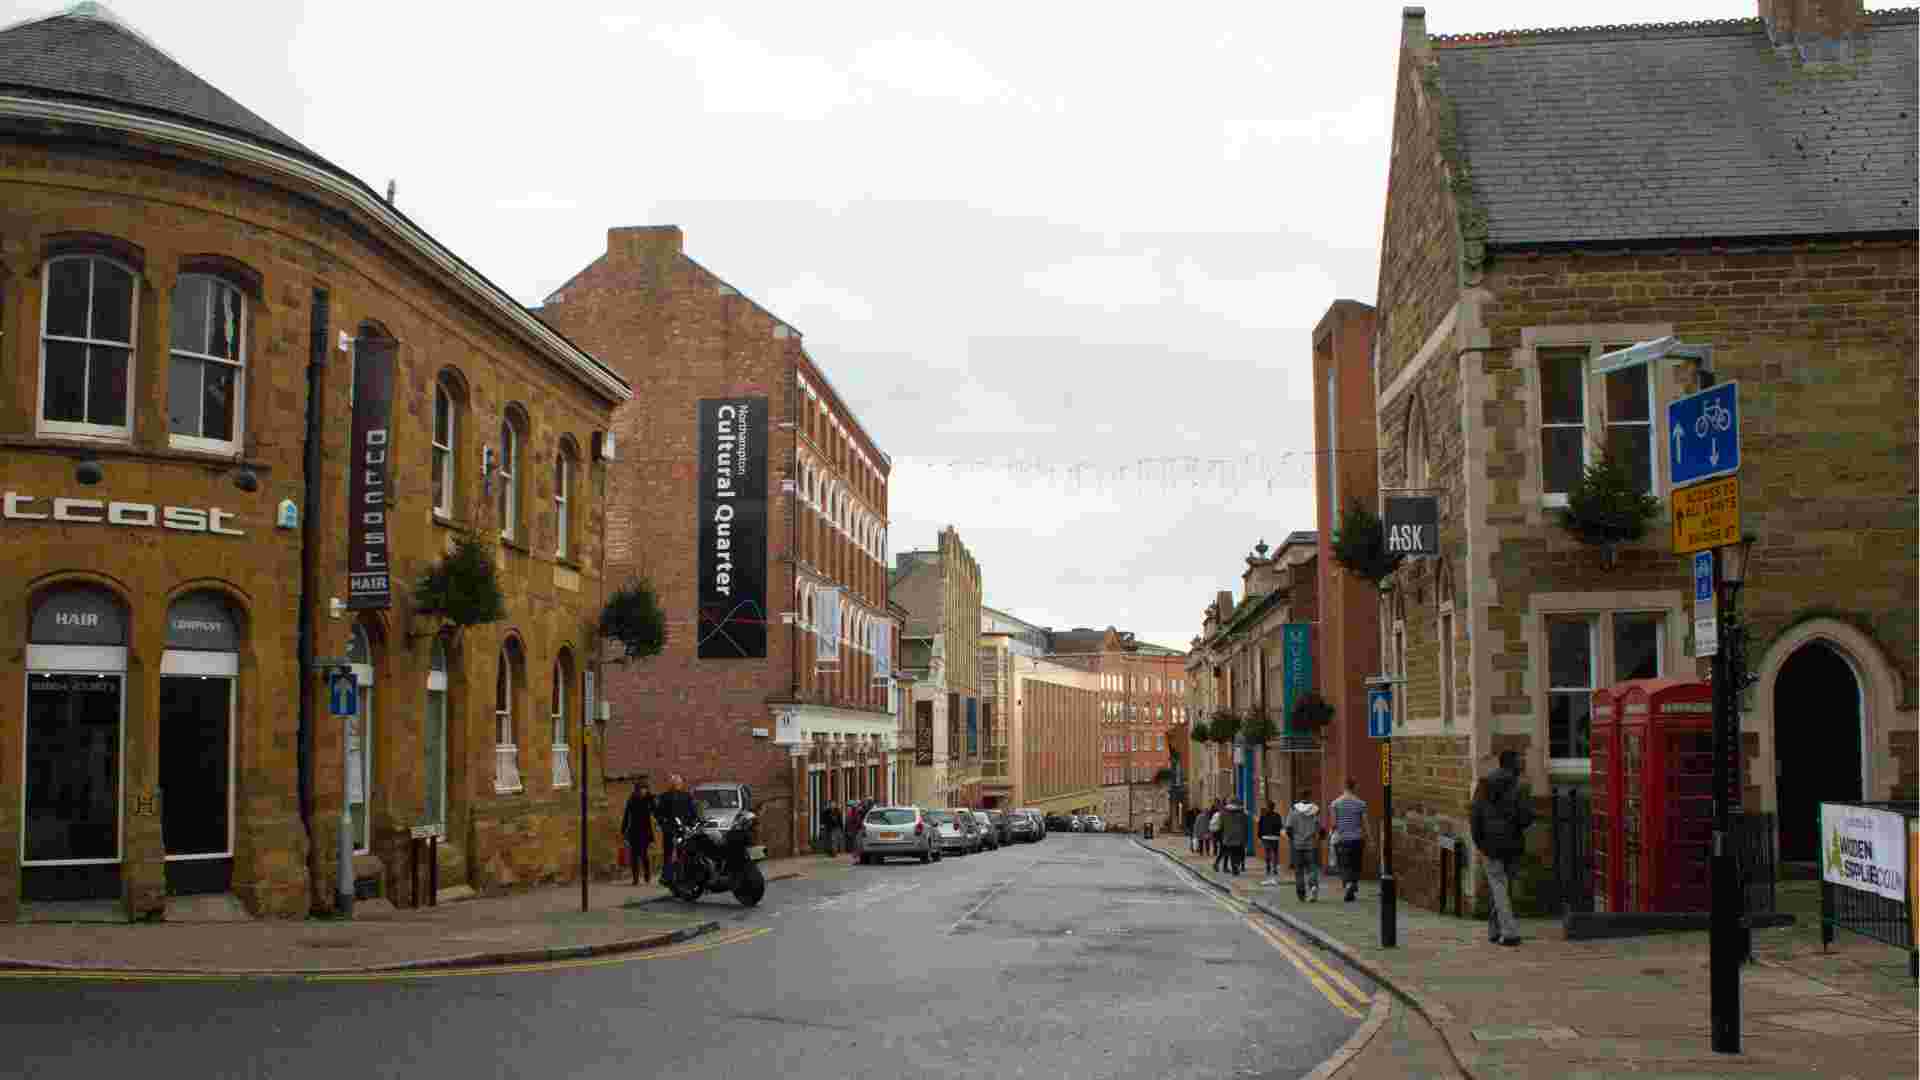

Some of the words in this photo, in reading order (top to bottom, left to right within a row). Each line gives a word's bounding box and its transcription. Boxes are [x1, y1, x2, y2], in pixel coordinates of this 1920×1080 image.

[716, 404, 736, 497] Cultural
[714, 504, 735, 595] Quarter
[1389, 524, 1424, 551] ASK
[351, 577, 387, 590] HAIR
[56, 612, 98, 627] HAIR
